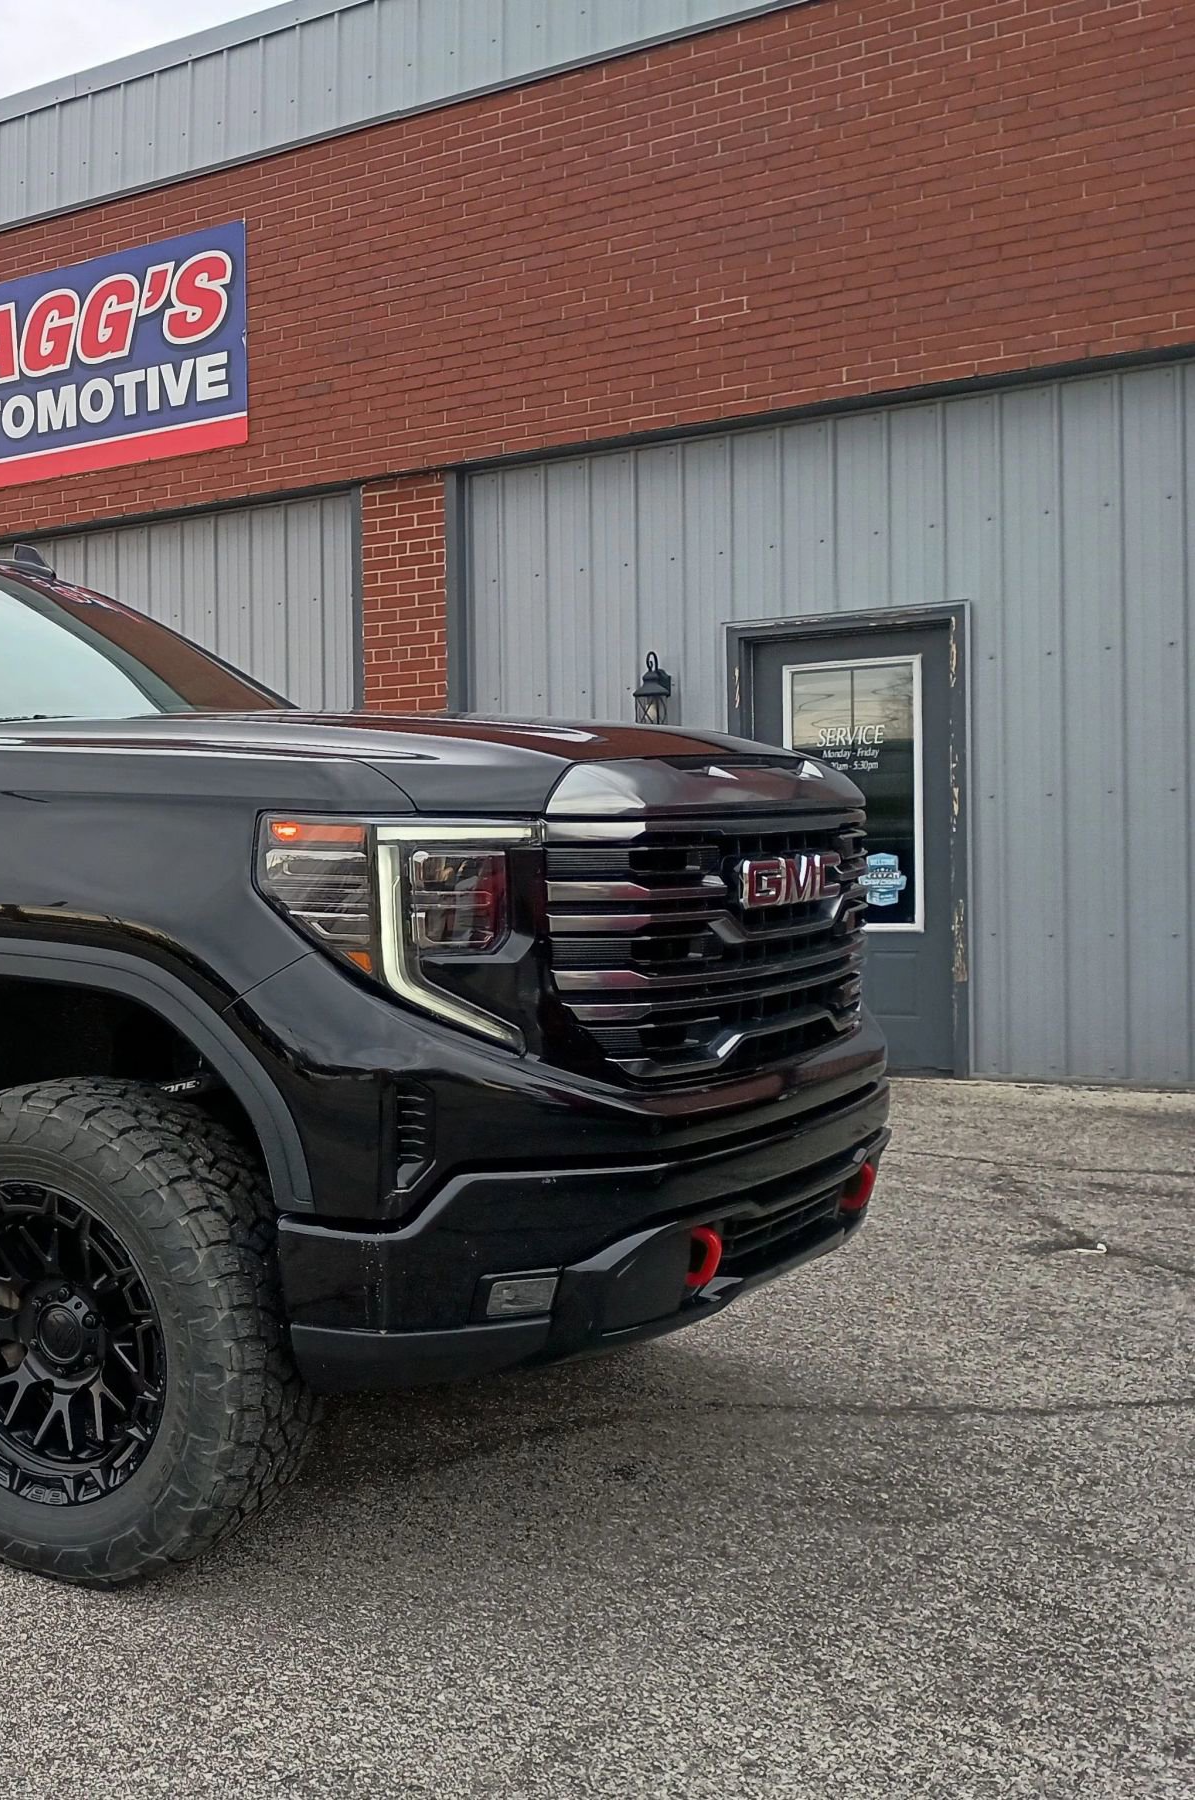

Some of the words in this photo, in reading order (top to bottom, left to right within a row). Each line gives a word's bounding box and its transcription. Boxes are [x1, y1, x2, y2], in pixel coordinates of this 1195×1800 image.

[816, 725, 885, 747] SERVICE
[822, 748, 851, 760] Monday
[856, 747, 880, 758] Friday
[853, 760, 879, 772] 5:30pm
[741, 852, 842, 909] GMC
[160, 1080, 197, 1093] ONE
